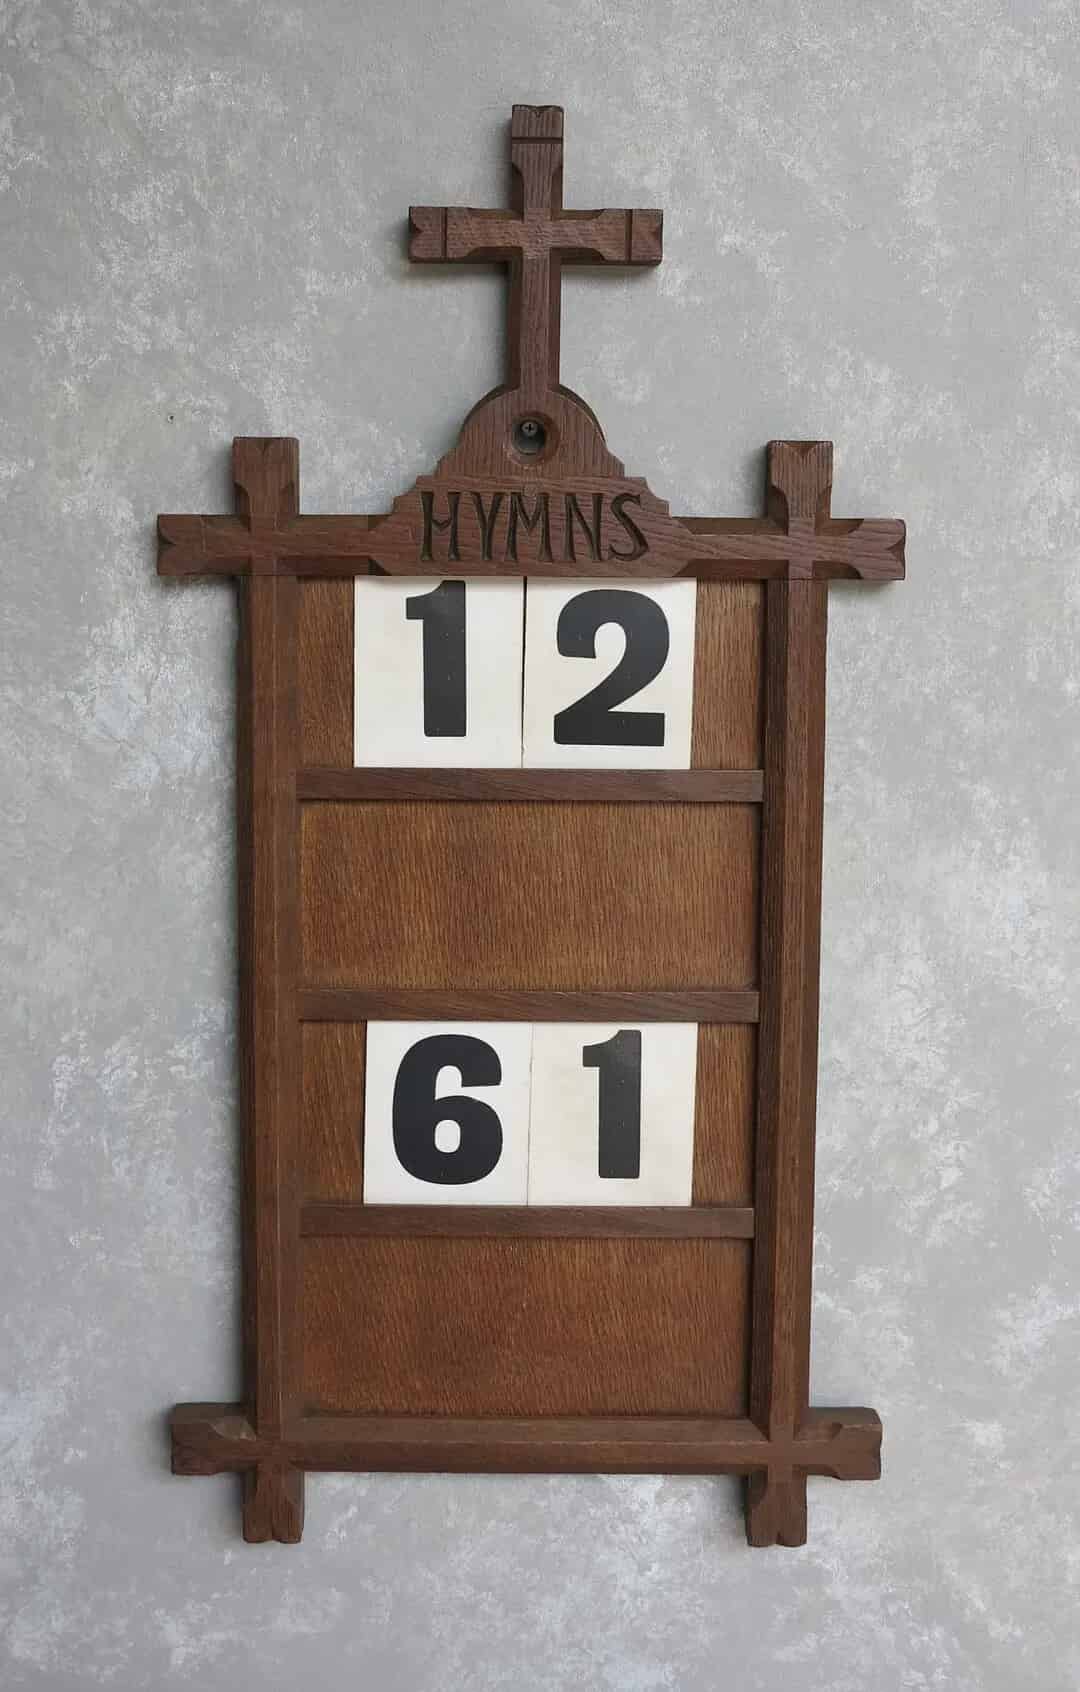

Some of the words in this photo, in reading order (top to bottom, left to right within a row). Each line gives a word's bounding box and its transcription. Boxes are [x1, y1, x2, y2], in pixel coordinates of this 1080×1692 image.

[420, 491, 649, 563] HYMNS
[406, 579, 670, 747] 12
[392, 1029, 642, 1185] 61
